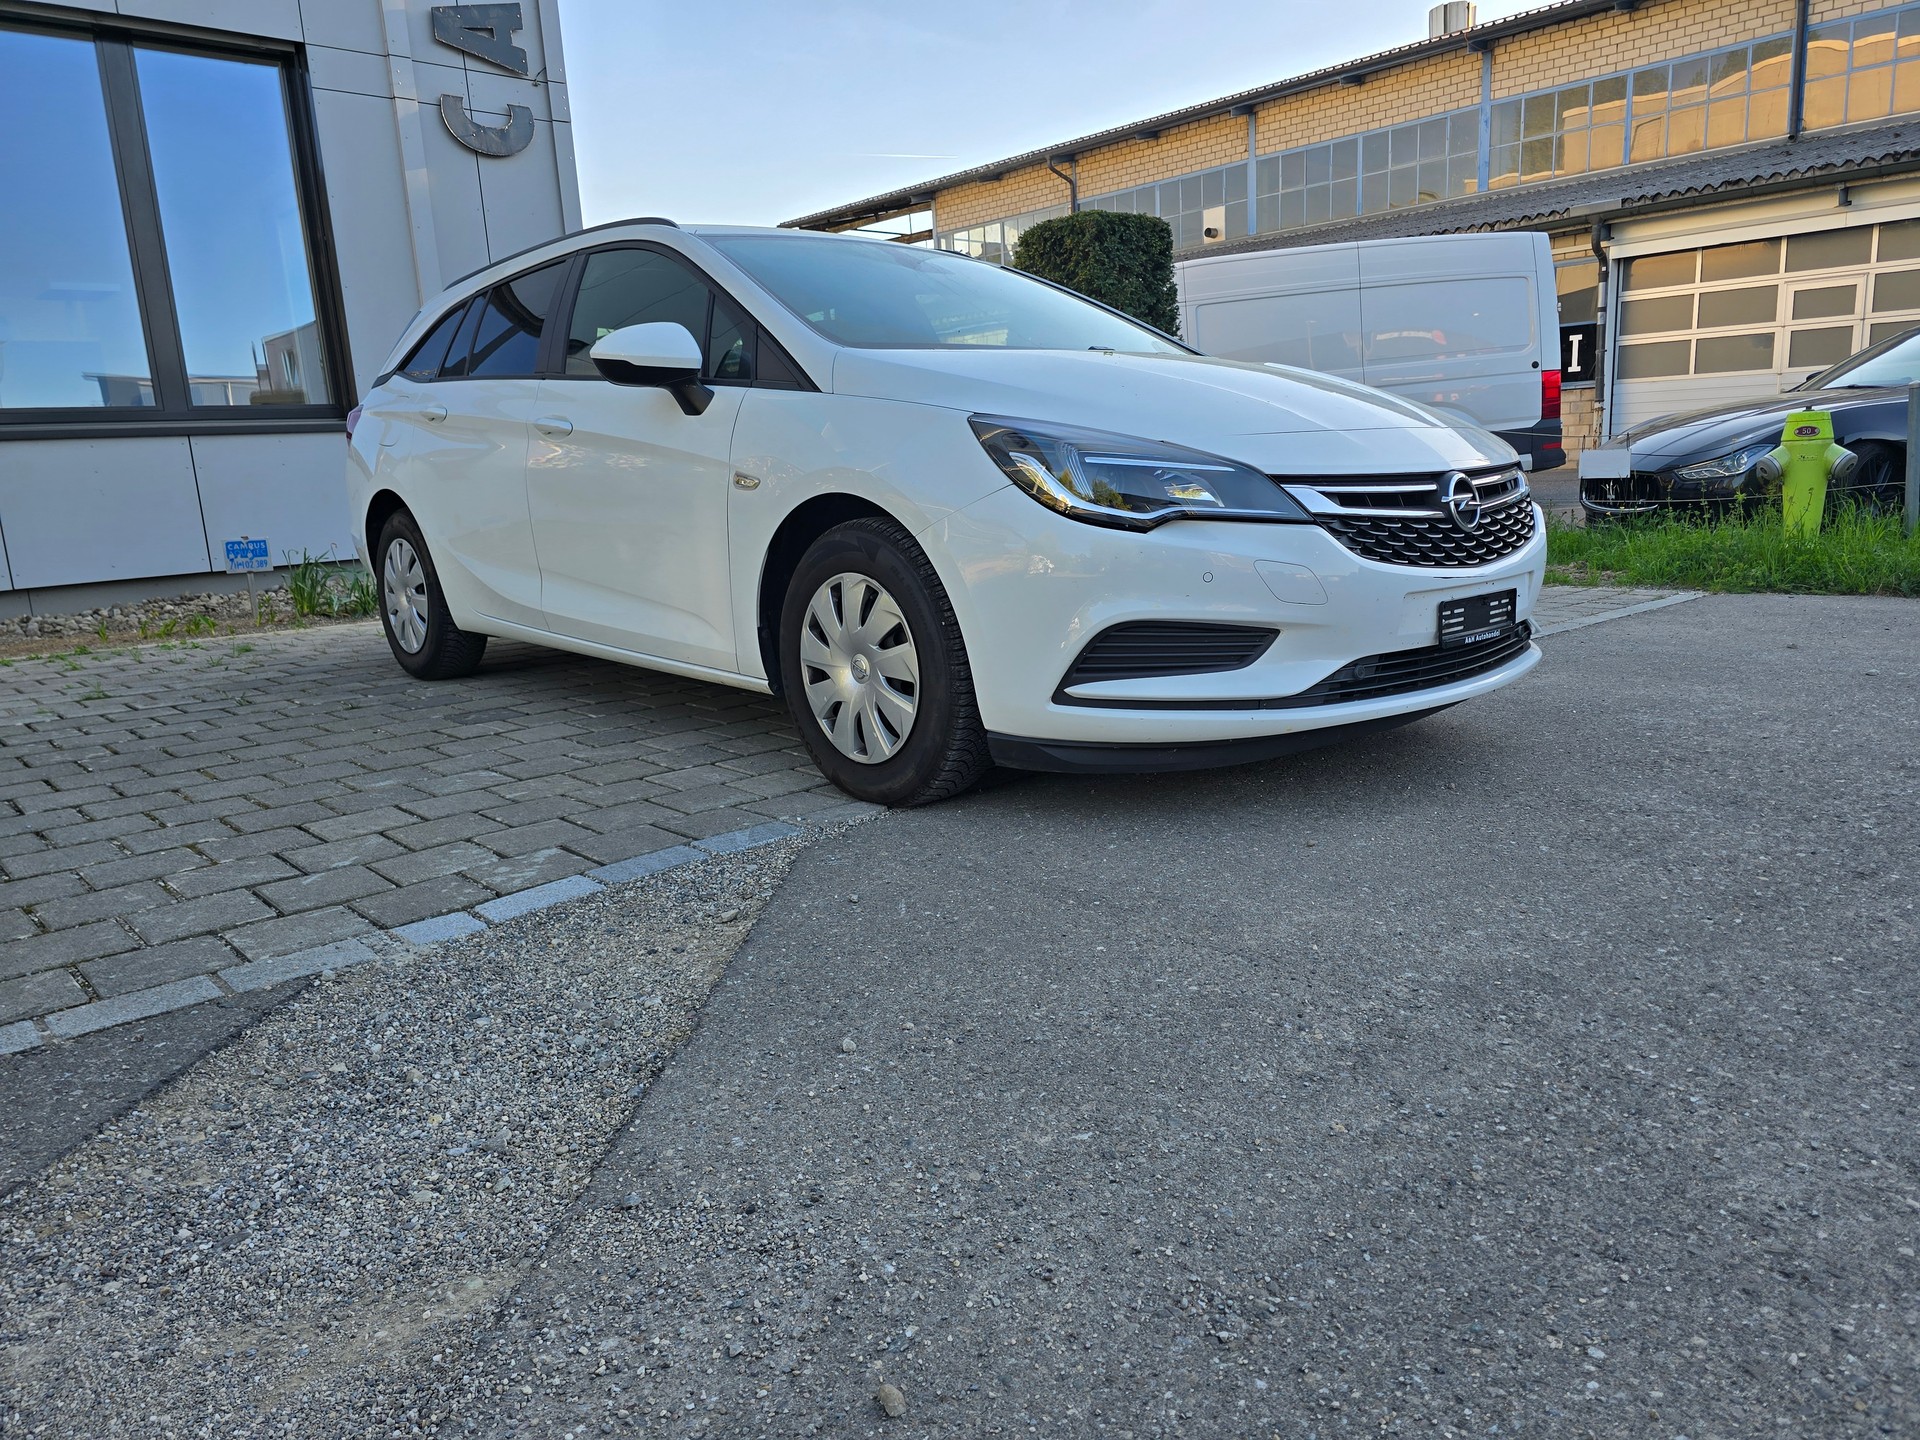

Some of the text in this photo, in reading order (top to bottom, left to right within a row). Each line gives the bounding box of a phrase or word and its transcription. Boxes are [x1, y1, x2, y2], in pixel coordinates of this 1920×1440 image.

[1802, 427, 1812, 435] 50
[227, 541, 266, 550] CAMPUS
[256, 559, 268, 569] 389
[1475, 629, 1501, 642] Autohandel
